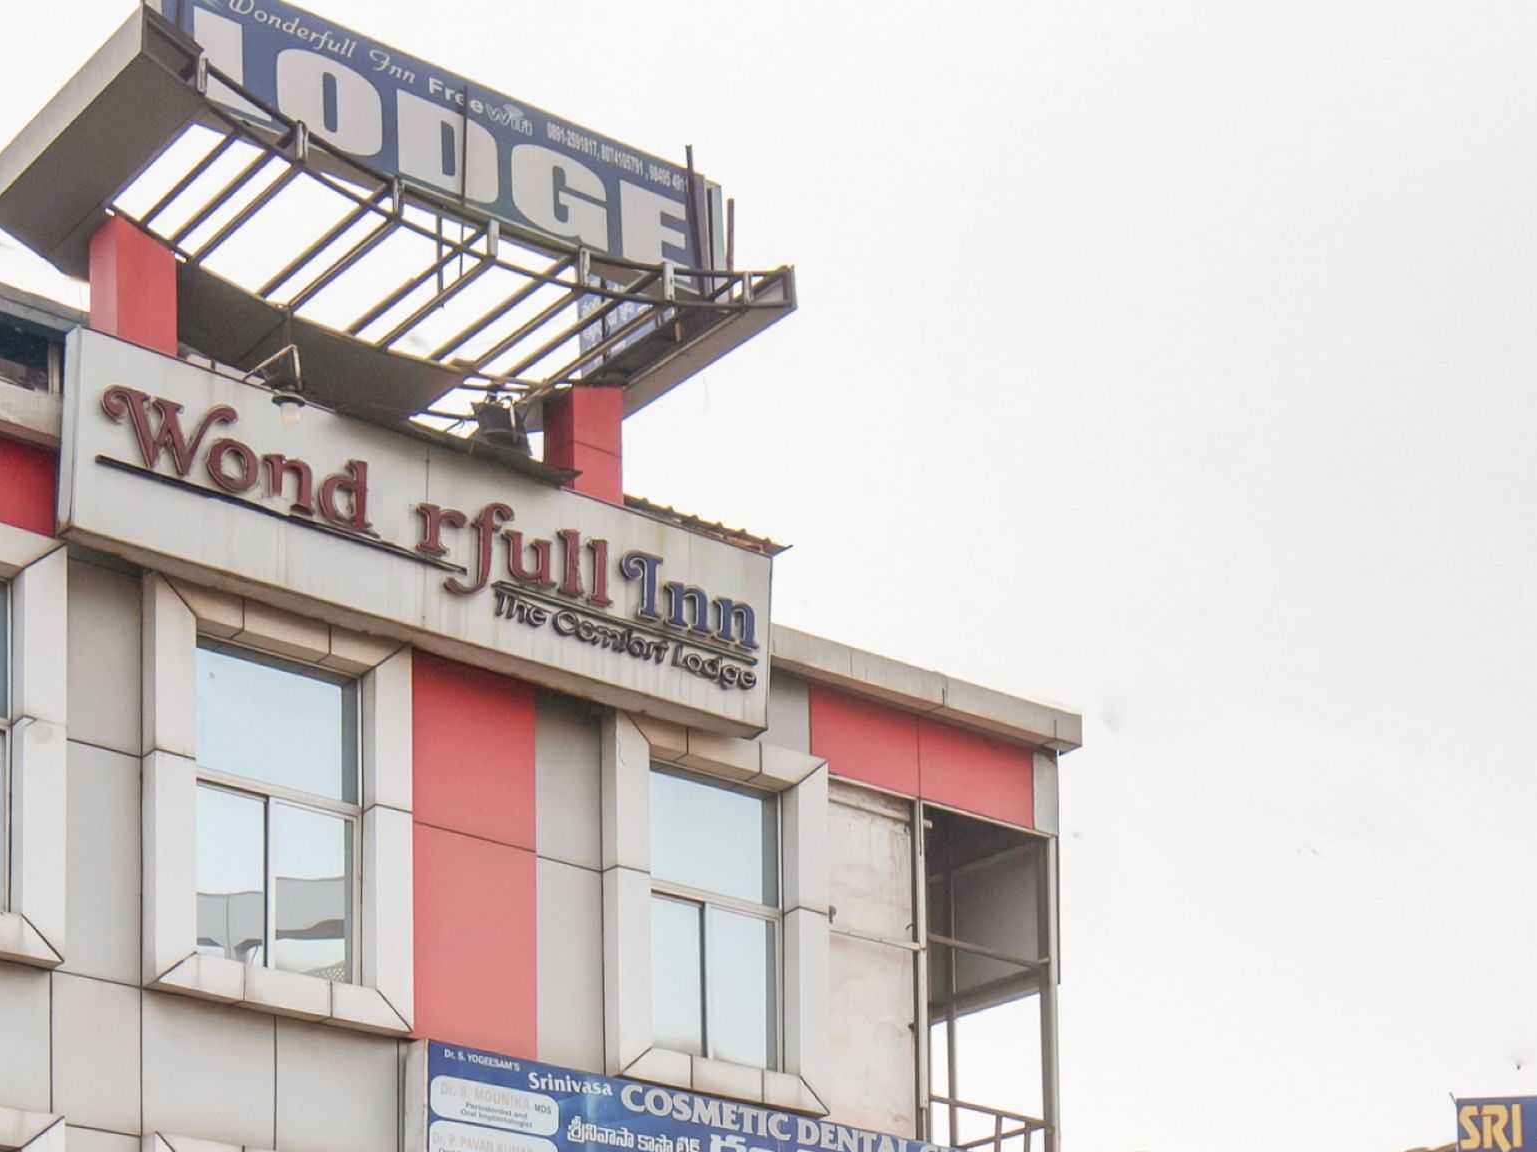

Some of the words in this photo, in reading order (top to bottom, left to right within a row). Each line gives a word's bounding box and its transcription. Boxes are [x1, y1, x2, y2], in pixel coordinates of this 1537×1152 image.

[369, 49, 416, 86] Inn
[428, 76, 485, 115] Free
[193, 5, 699, 290] LODGE
[494, 587, 546, 628] The
[552, 607, 671, 666] Comfort
[672, 645, 758, 691] Lodge
[620, 549, 759, 650] Inn
[527, 1071, 613, 1096] Srinivasa
[621, 1084, 792, 1142] COSMETIC
